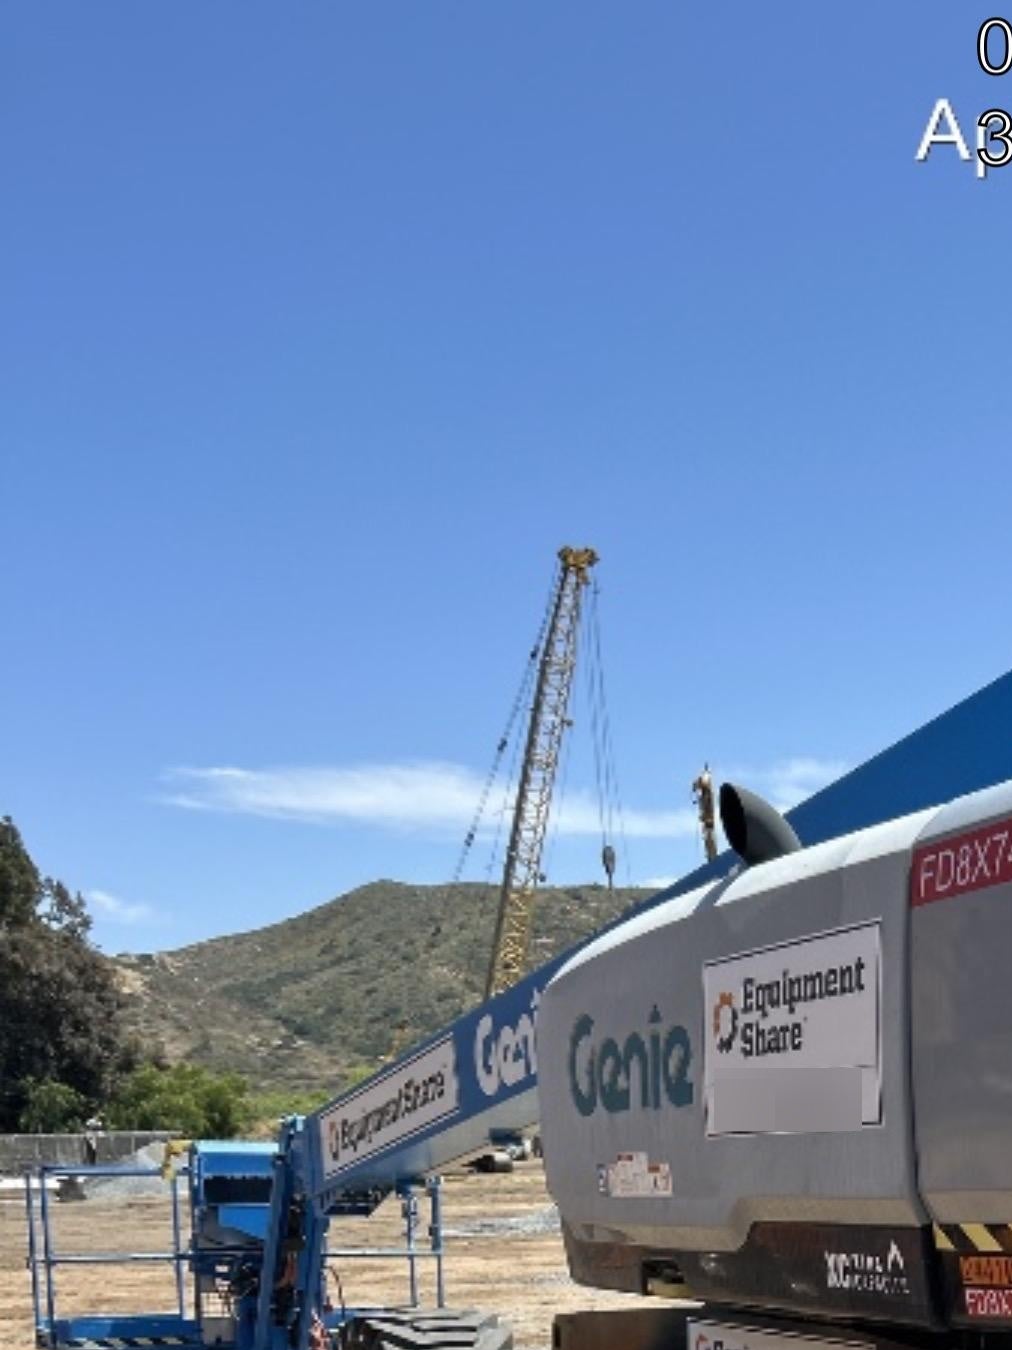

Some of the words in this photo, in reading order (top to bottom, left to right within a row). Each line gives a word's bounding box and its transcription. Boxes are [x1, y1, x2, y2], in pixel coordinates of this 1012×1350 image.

[740, 955, 866, 1019] Equipment
[568, 1003, 695, 1117] Genie
[740, 1020, 804, 1059] Share
